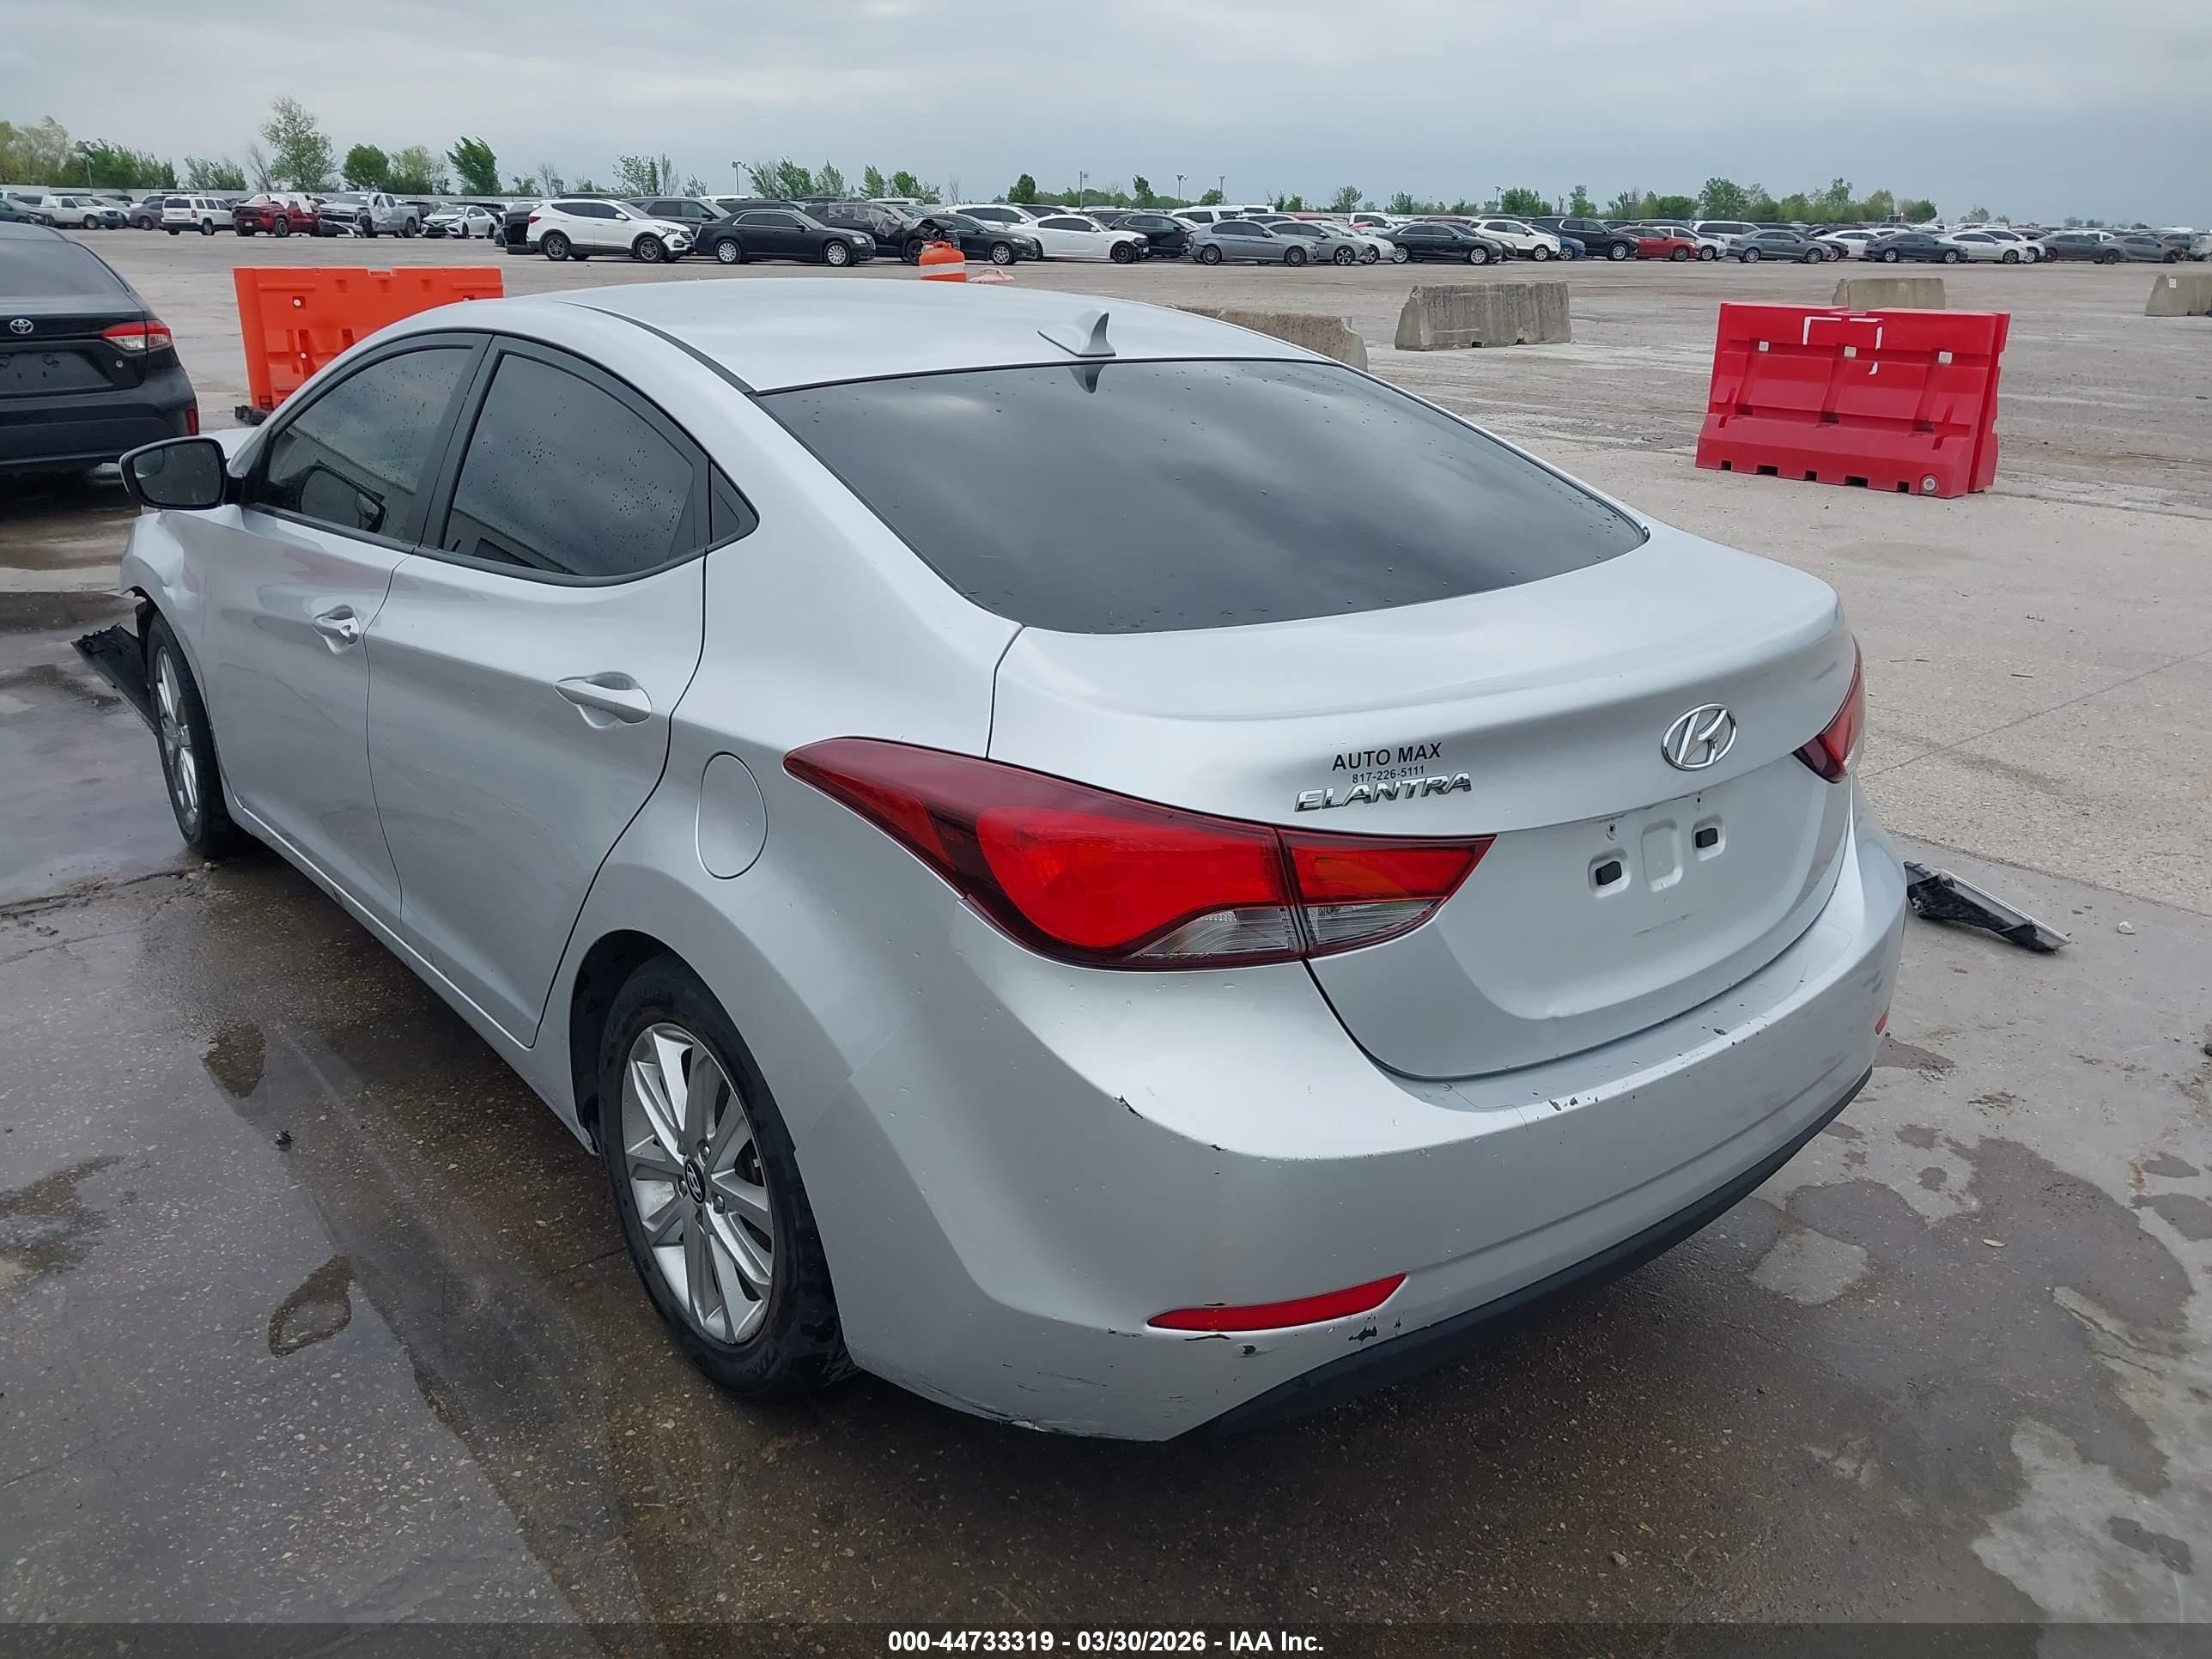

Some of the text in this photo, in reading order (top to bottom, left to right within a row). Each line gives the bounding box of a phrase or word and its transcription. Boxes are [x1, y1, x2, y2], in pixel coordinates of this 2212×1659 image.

[1332, 741, 1443, 771] AUTO MAX
[1352, 764, 1425, 784] 817-226-5111
[1294, 771, 1472, 812] ELANTRA
